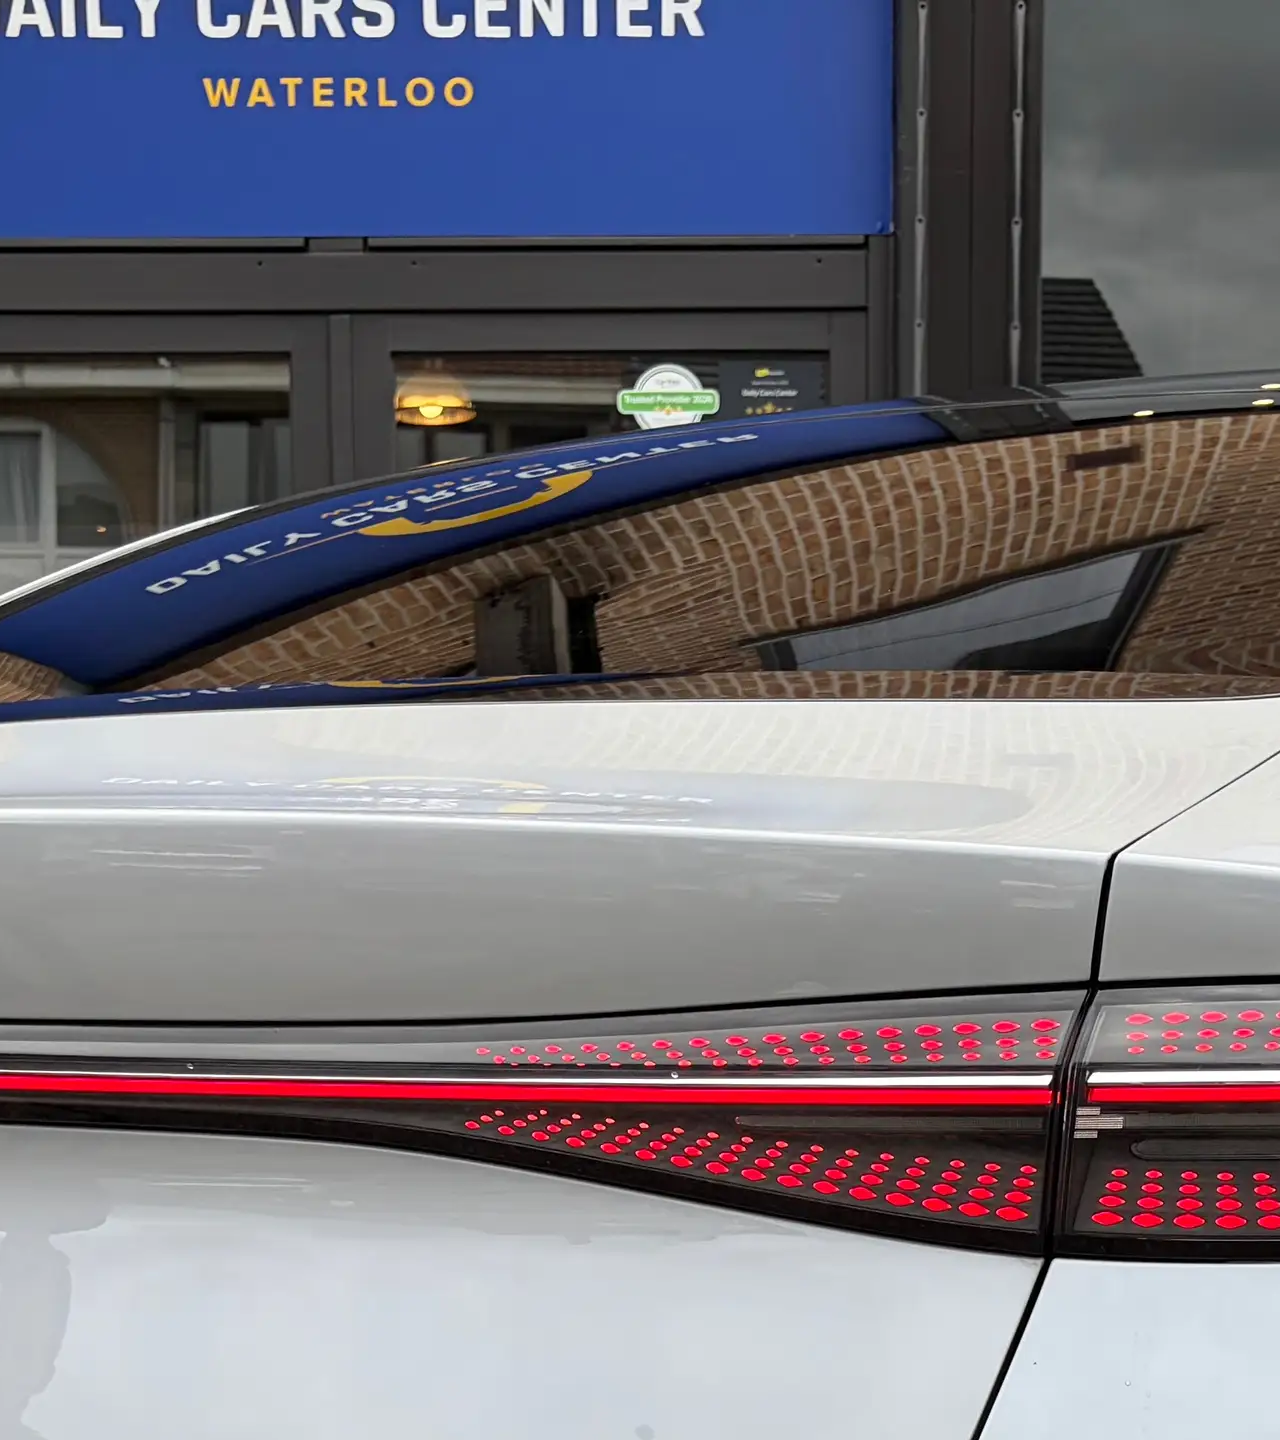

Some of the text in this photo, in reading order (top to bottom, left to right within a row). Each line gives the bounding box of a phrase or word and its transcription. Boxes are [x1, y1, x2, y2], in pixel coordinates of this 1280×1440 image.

[195, 0, 393, 40] CARS
[420, 0, 706, 39] CENTER
[202, 77, 476, 108] WATERLOO
